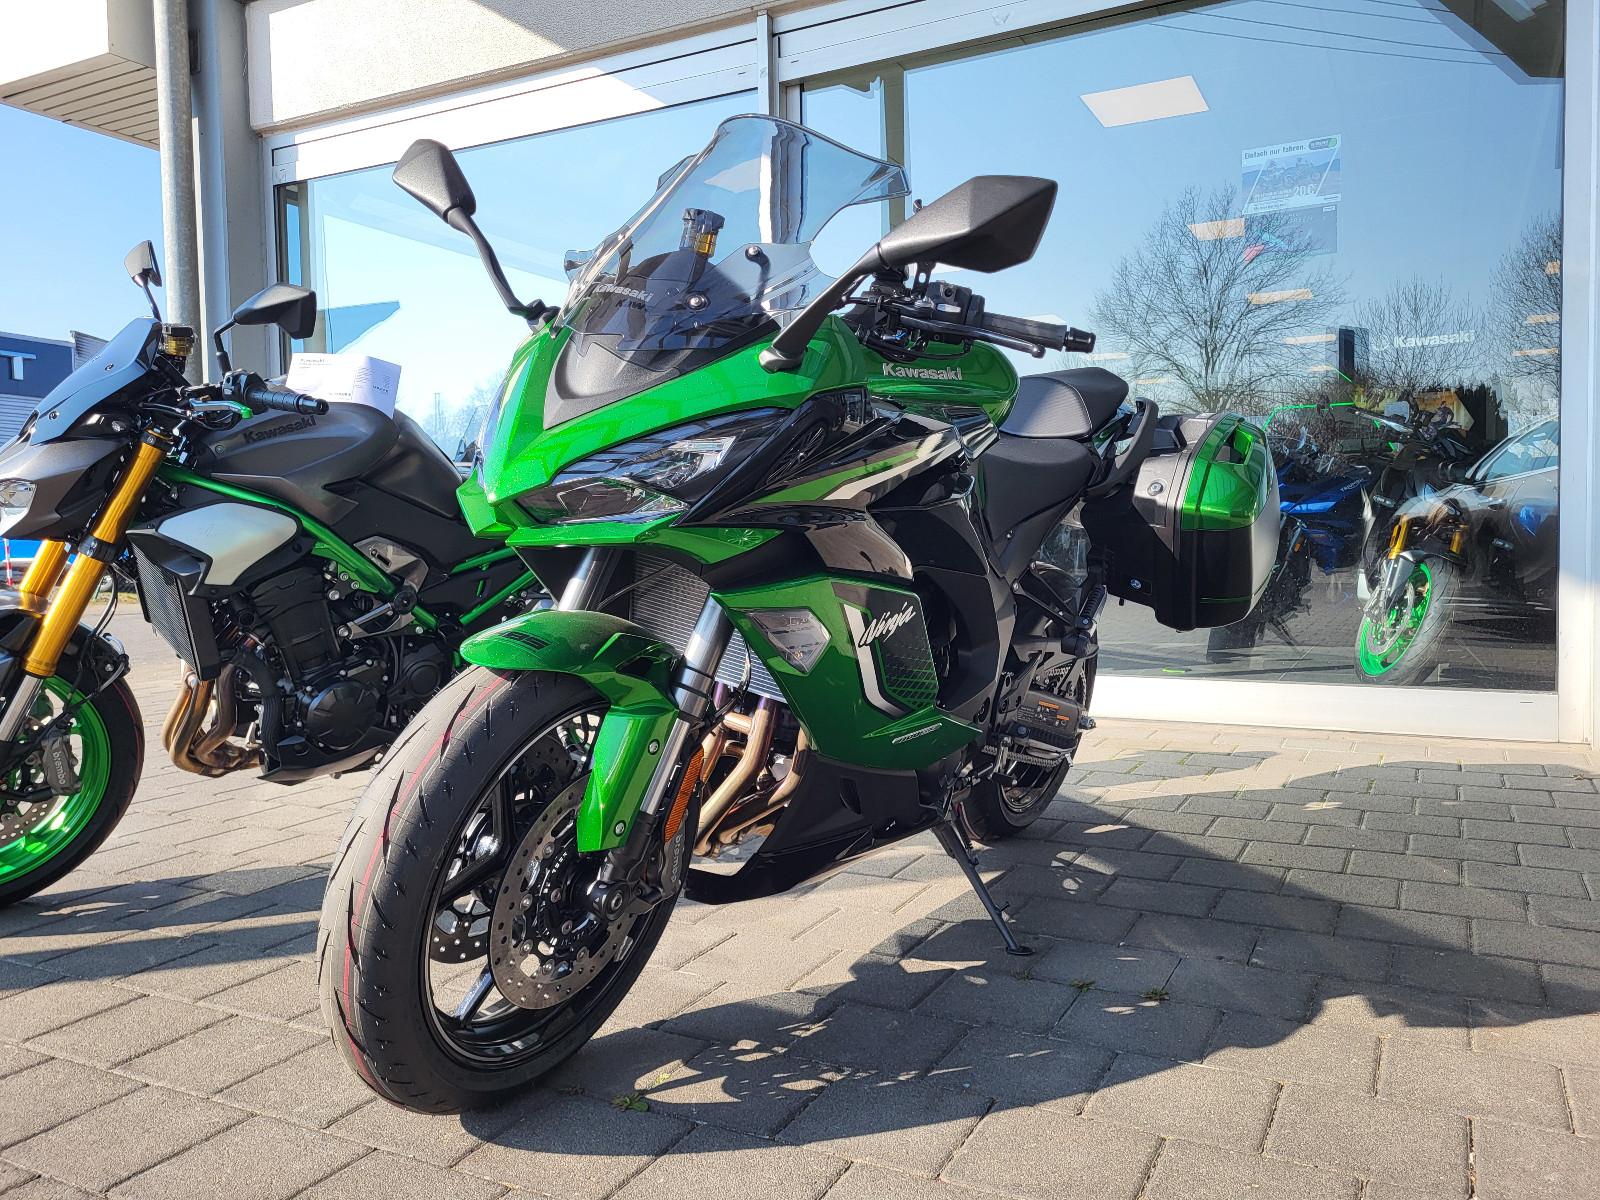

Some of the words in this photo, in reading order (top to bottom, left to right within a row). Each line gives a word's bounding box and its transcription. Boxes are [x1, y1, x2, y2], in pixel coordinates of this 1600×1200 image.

[1244, 149, 1268, 160] Einfach
[1269, 148, 1280, 156] nur
[1393, 329, 1476, 348] Kawasaki
[882, 362, 963, 381] Kawasaki
[242, 415, 317, 444] Kawasaki
[858, 601, 917, 647] Ninja
[52, 751, 66, 786] brembo
